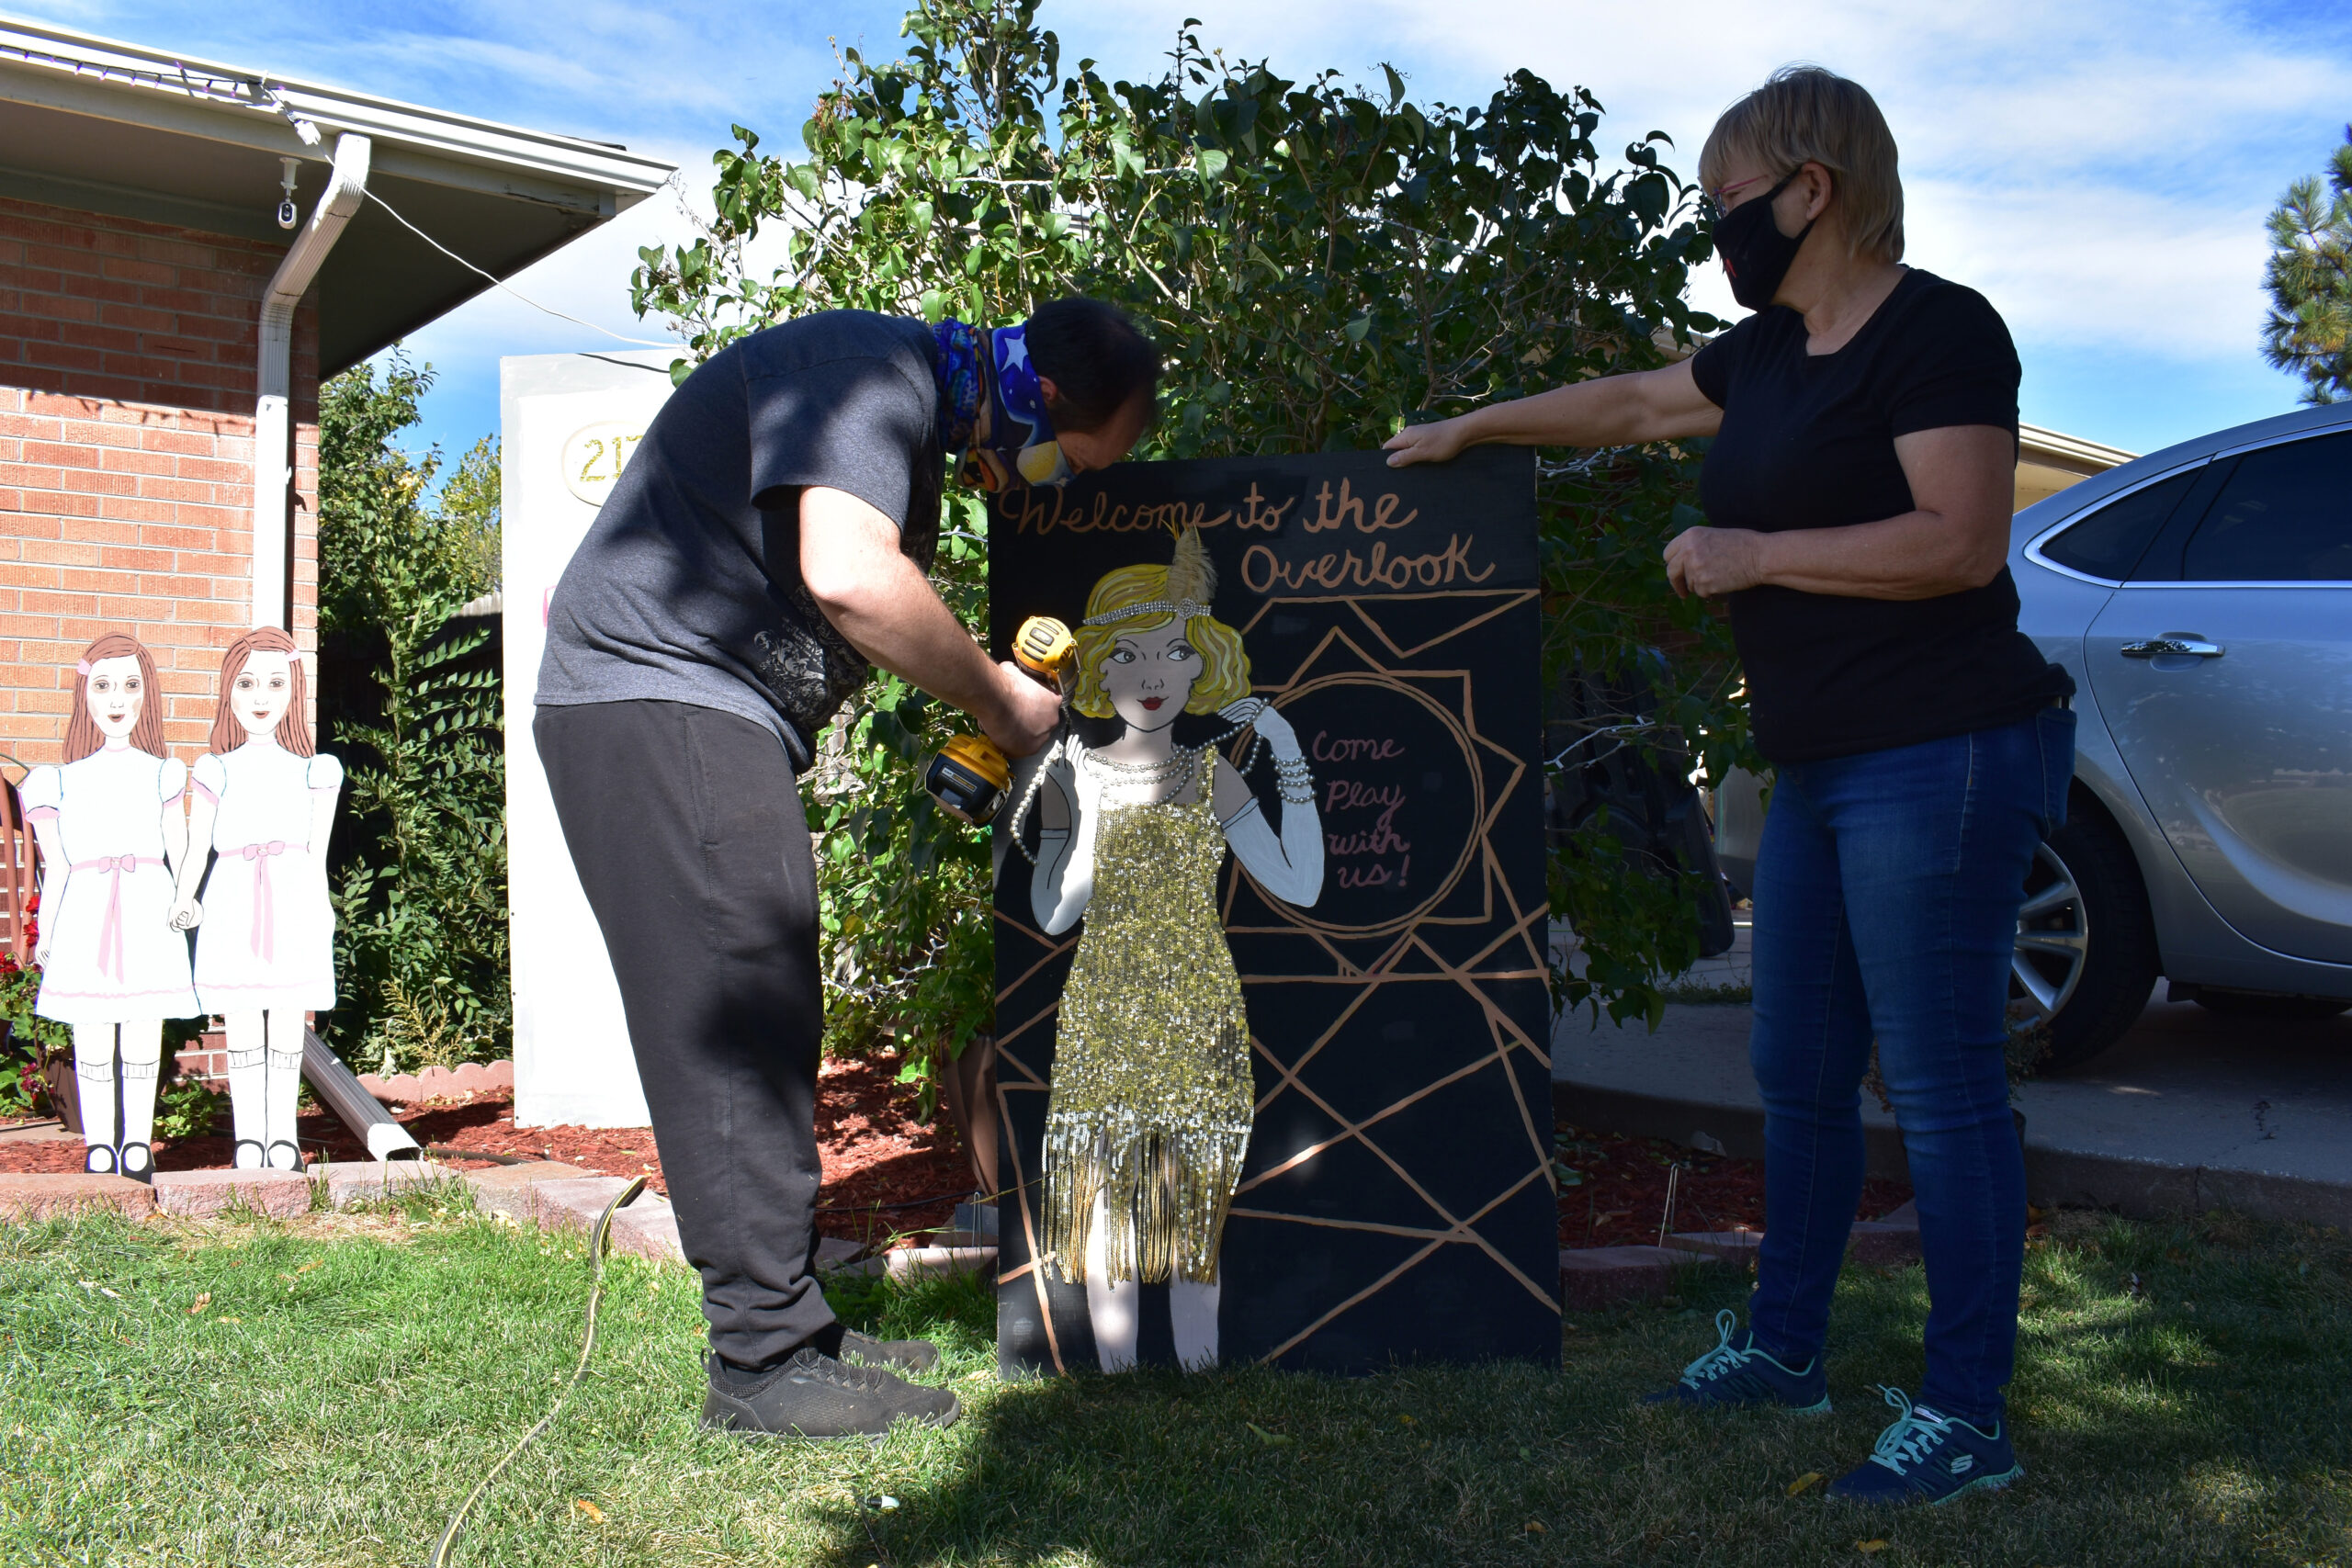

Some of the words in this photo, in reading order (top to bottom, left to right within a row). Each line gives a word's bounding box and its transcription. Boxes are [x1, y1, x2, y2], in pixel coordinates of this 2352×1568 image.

[998, 483, 1232, 536] Welcome
[1236, 481, 1295, 532] to
[1303, 477, 1419, 534] the
[1241, 533, 1497, 593] Overlook
[1312, 729, 1406, 762] Come
[1325, 780, 1407, 832] Play
[1327, 825, 1411, 855] with
[1337, 853, 1411, 889] us!
